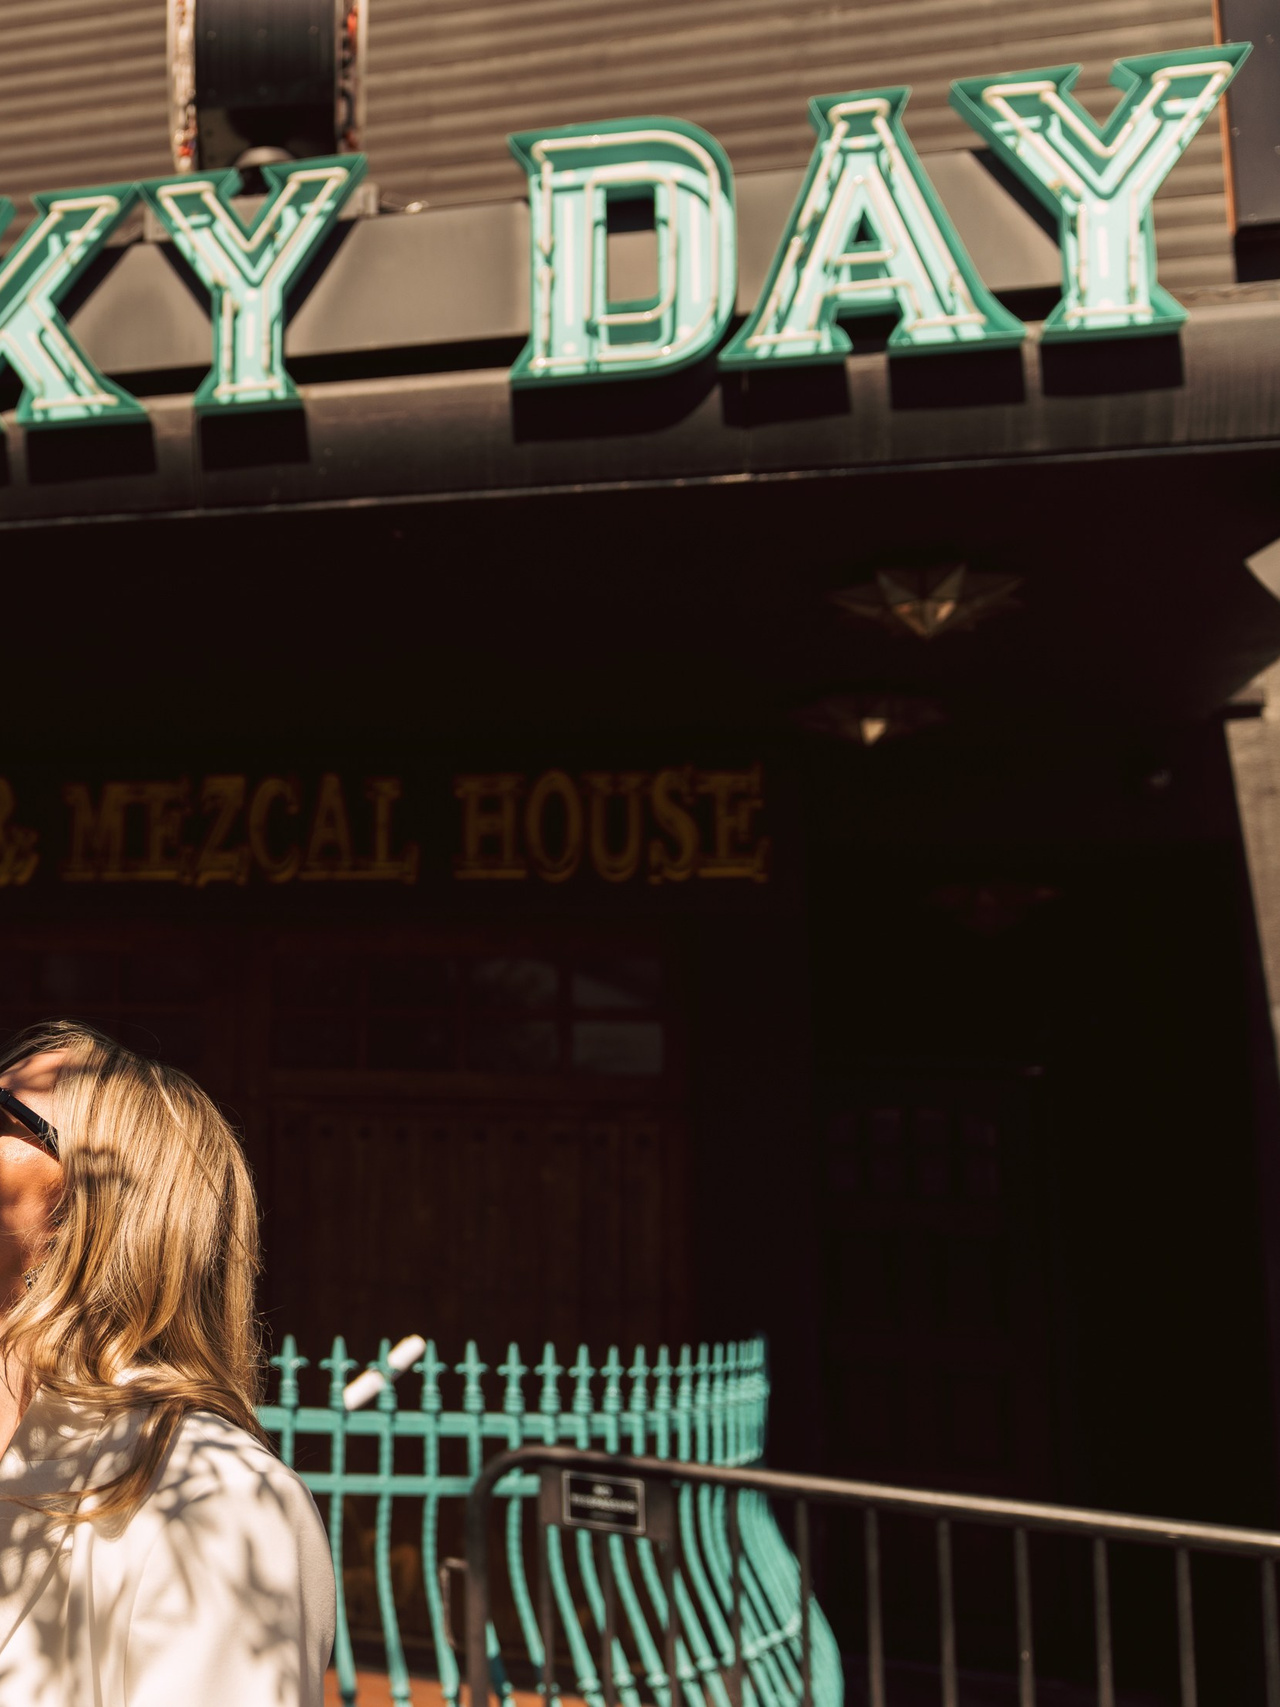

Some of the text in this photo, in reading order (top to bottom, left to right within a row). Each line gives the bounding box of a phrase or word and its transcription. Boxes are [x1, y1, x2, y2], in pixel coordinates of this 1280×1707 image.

[507, 42, 1254, 387] DAY
[62, 773, 418, 887] MEZCAL
[453, 765, 768, 885] HOUSE
